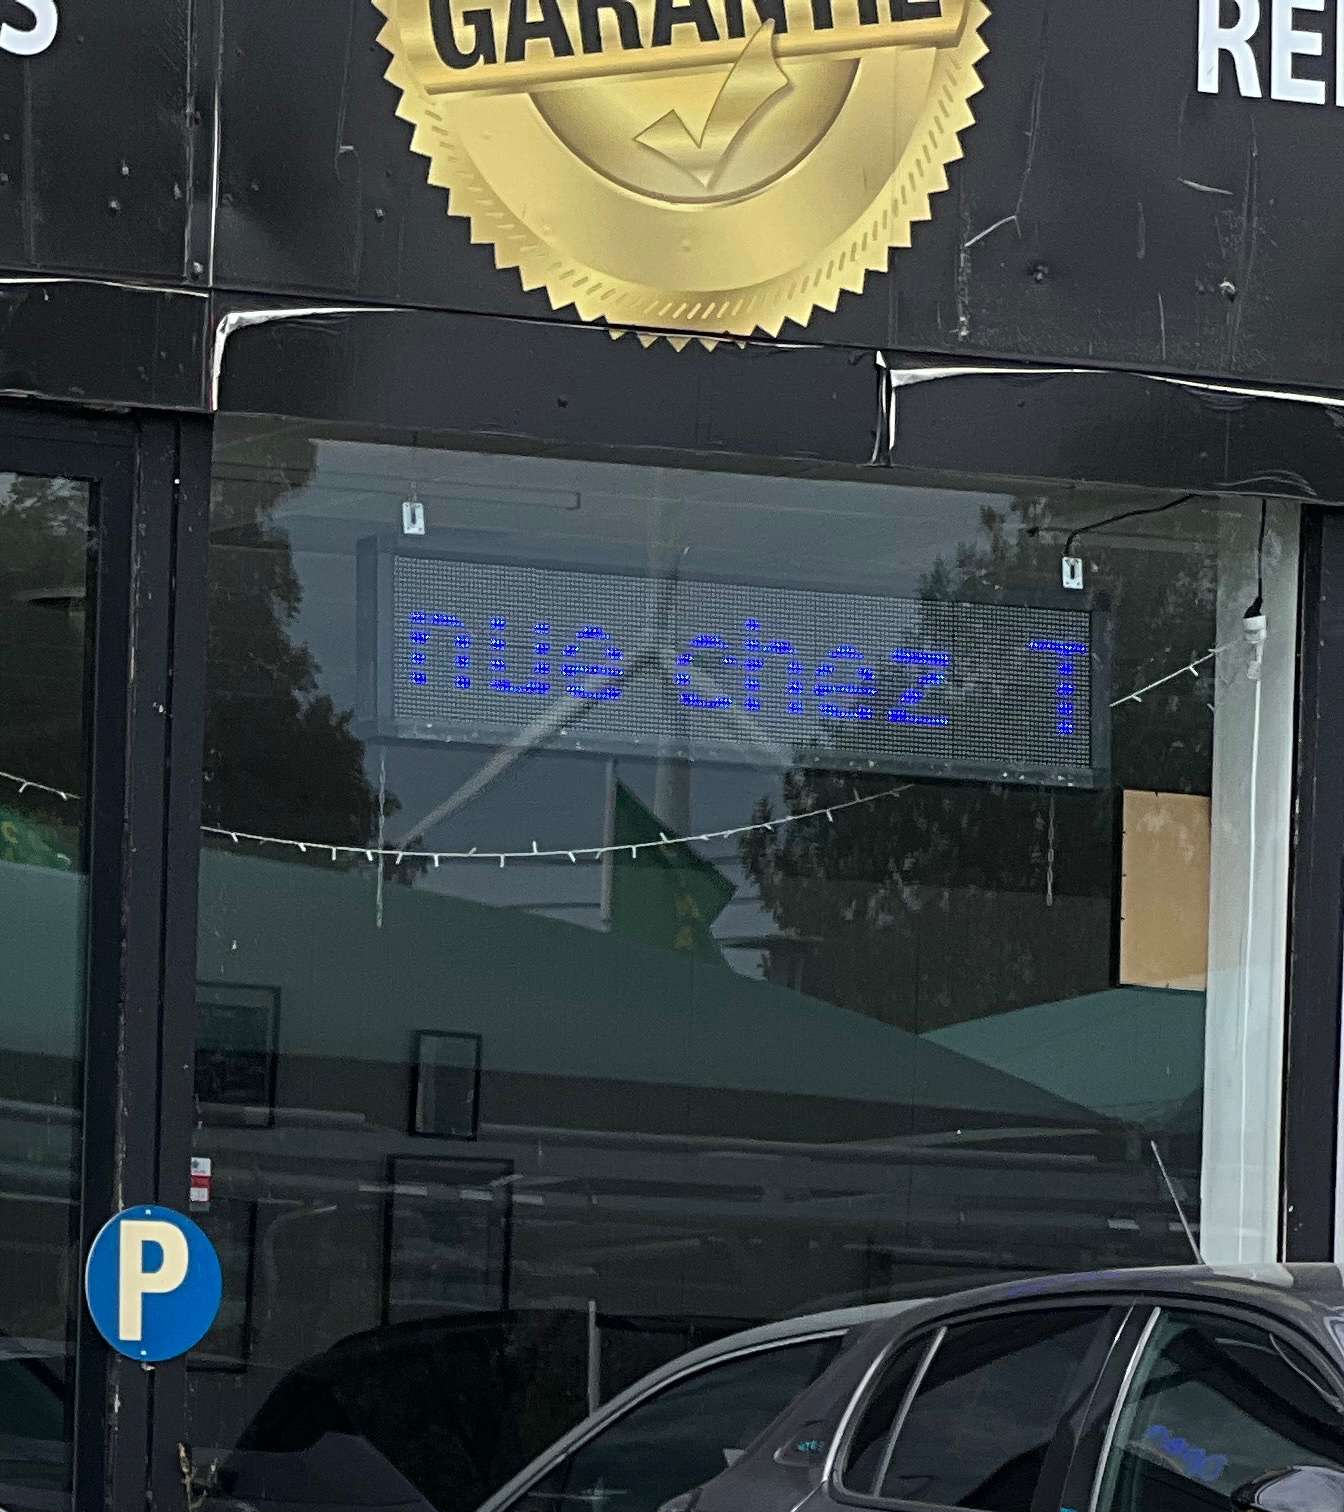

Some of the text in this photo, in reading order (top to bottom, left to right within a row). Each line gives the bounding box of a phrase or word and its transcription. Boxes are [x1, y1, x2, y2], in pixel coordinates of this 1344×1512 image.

[1197, 0, 1344, 107] RE
[408, 611, 1088, 736] nue chez T
[119, 1220, 189, 1342] P
